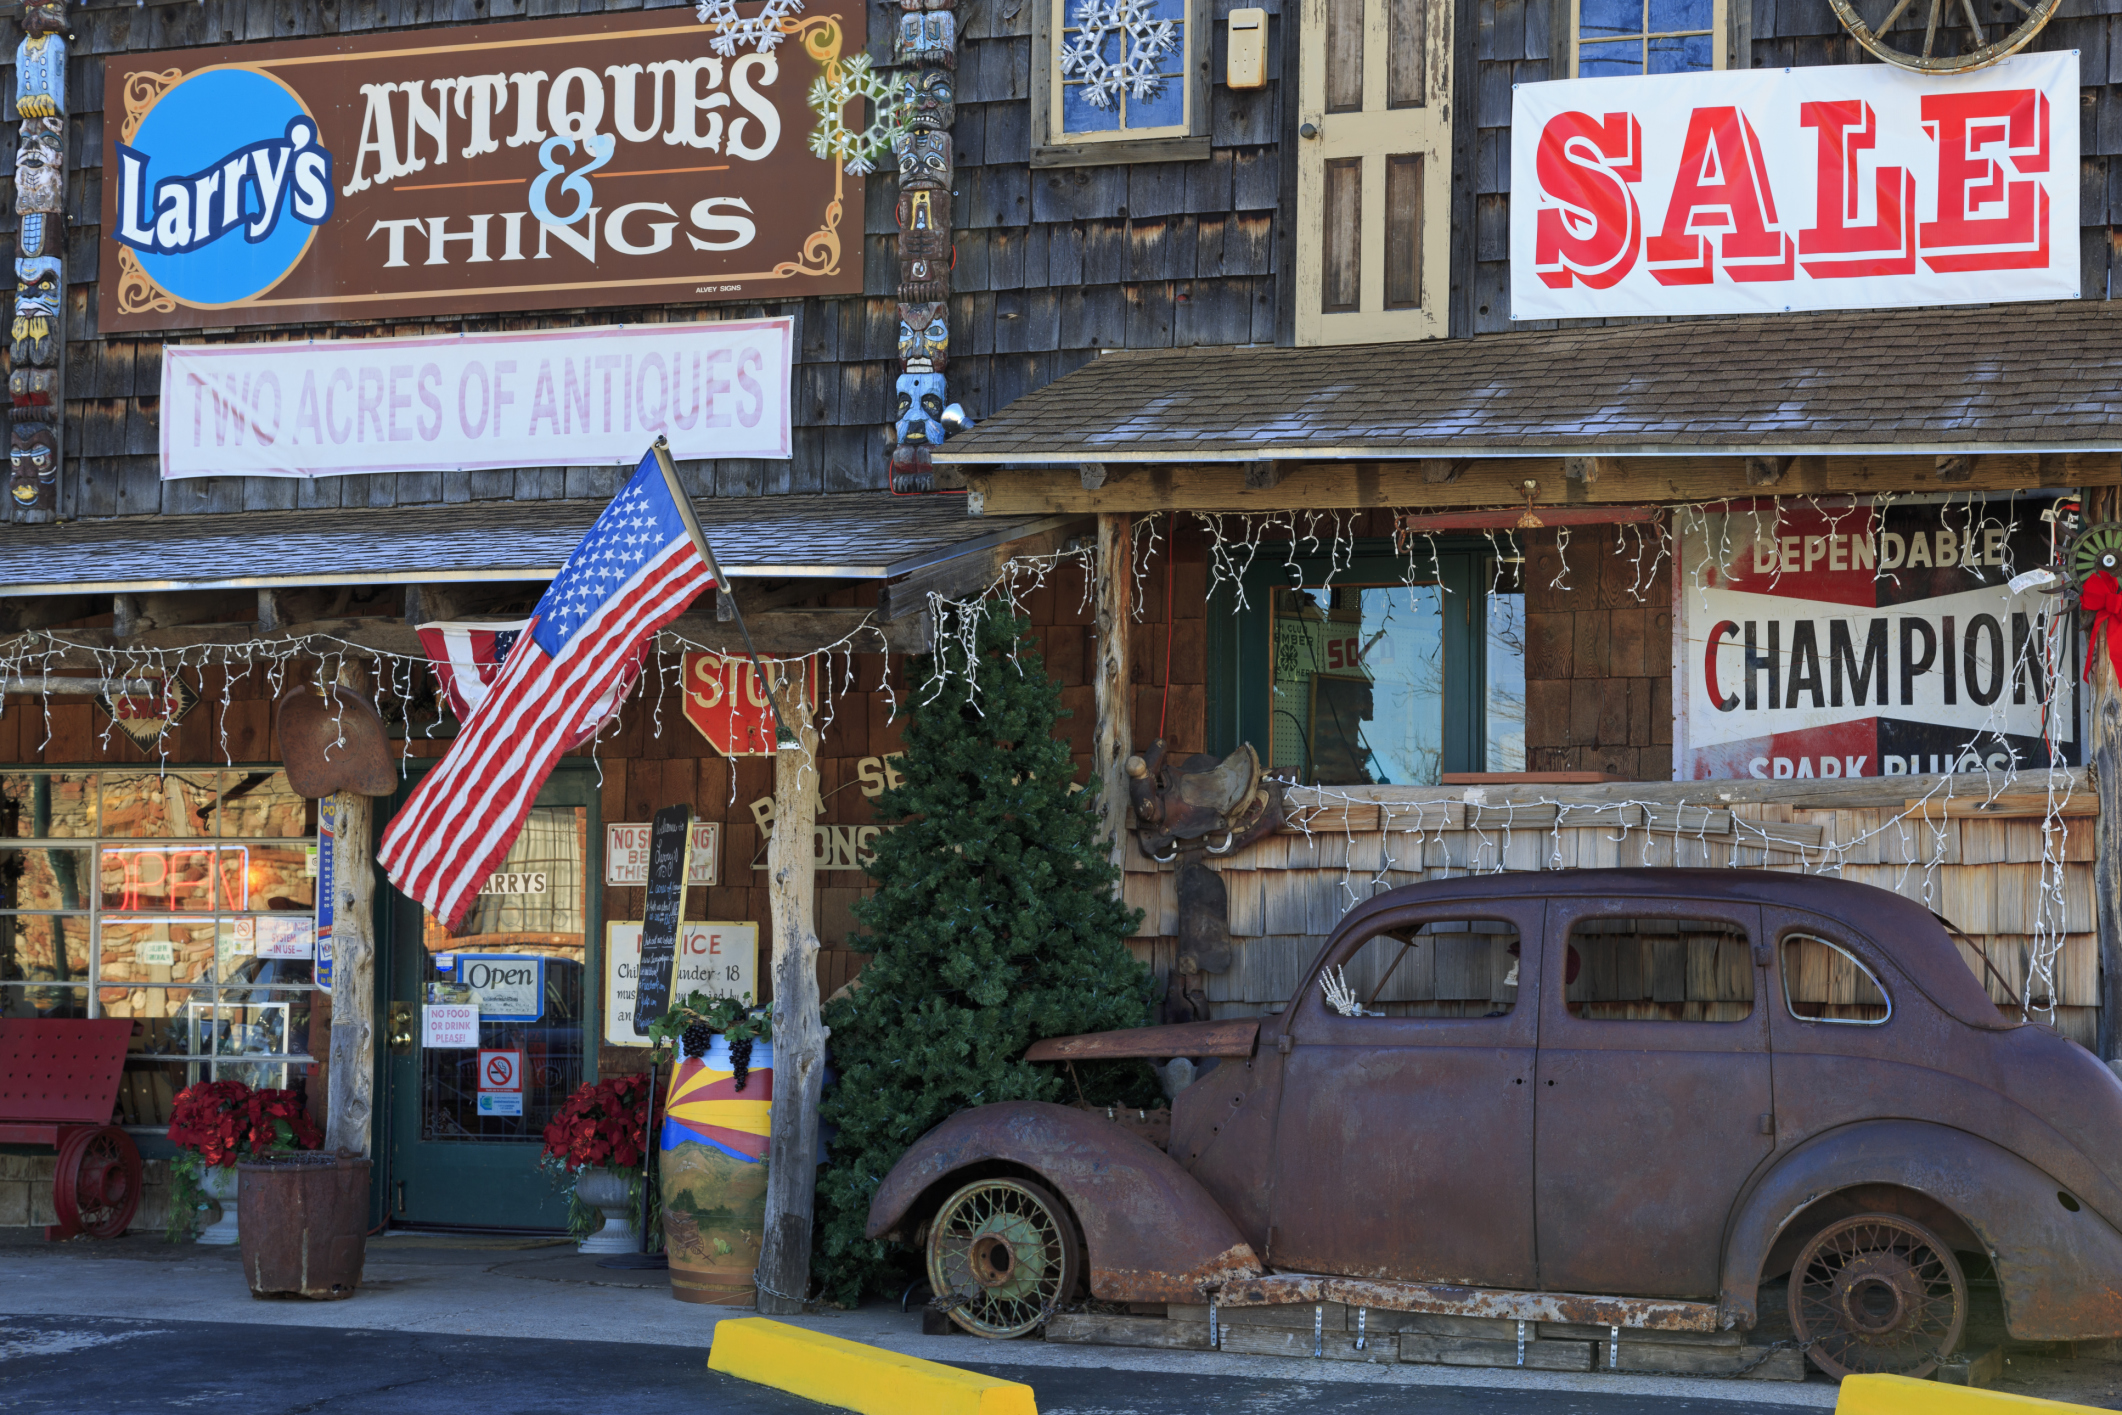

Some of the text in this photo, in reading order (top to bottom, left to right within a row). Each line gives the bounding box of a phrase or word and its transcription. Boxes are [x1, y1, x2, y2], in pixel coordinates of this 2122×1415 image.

[344, 51, 781, 196] ANTIQUES
[118, 118, 330, 252] Larry's
[530, 134, 615, 226] &
[1535, 88, 2050, 290] SALE
[367, 197, 757, 267] THINGS
[719, 284, 742, 292] SIGNS
[187, 347, 763, 449] TWO ACRES OF ANTIQUES
[1753, 528, 2002, 574] DEPENDABLE
[1704, 612, 2050, 713] CHAMPION
[694, 654, 775, 709] STO
[614, 829, 634, 849] NO
[615, 865, 648, 879] THIS
[481, 874, 545, 894] ARRYS
[460, 900, 568, 931] NTIQUES
[271, 933, 297, 943] SYSTEM
[273, 945, 296, 954] IN USE
[469, 963, 533, 990] Open
[726, 965, 740, 981] 18
[617, 990, 636, 1000] mus
[431, 1009, 470, 1018] NO FOOD
[618, 1011, 632, 1021] an
[431, 1021, 471, 1030] OR DRINK
[436, 1033, 466, 1043] PLEASE!
